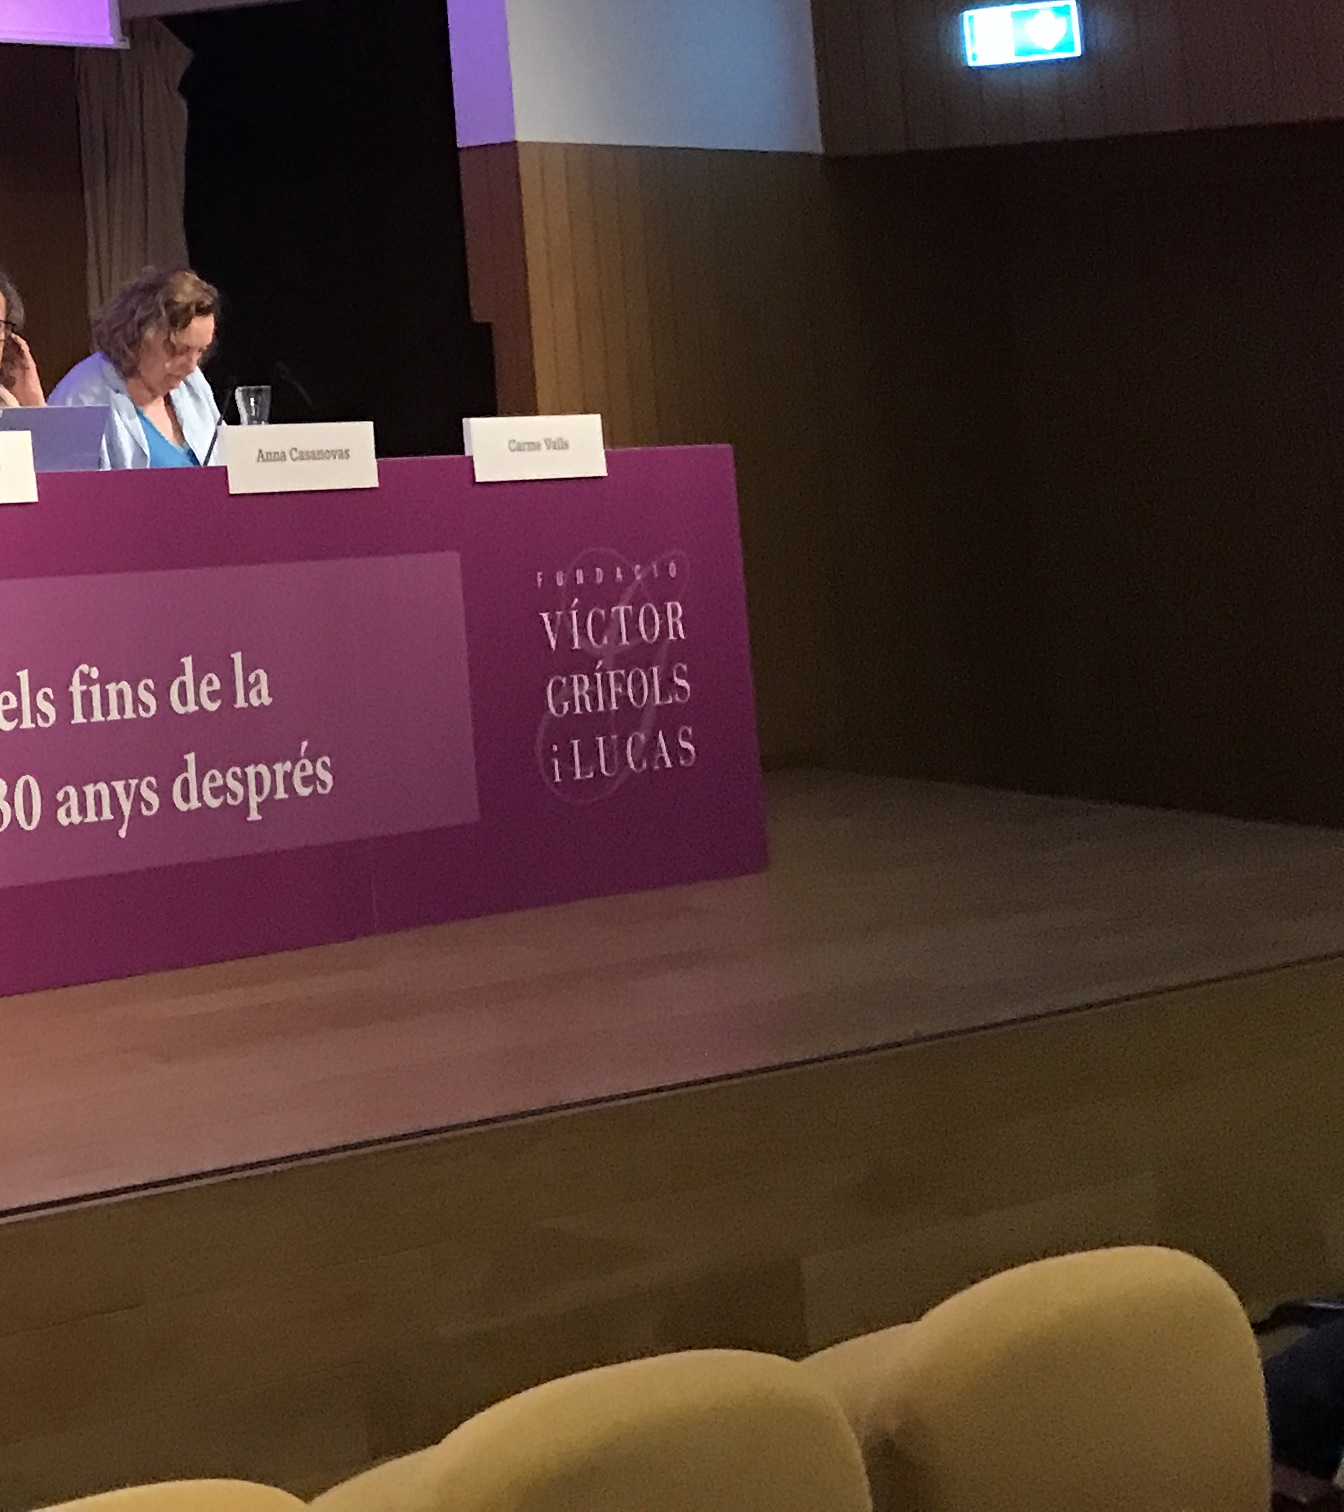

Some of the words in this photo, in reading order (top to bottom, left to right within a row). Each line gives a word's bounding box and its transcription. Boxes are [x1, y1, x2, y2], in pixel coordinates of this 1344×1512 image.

[256, 448, 286, 462] Anna
[289, 447, 350, 462] Casanovas
[539, 598, 686, 652] VÍCTOR
[68, 663, 156, 725] fins
[170, 654, 222, 715] de
[230, 650, 273, 709] la
[546, 660, 691, 717] GRÍFOLS
[551, 744, 561, 782] i
[570, 726, 696, 780] LUCAS
[56, 772, 159, 839] anys
[171, 740, 333, 821] després
